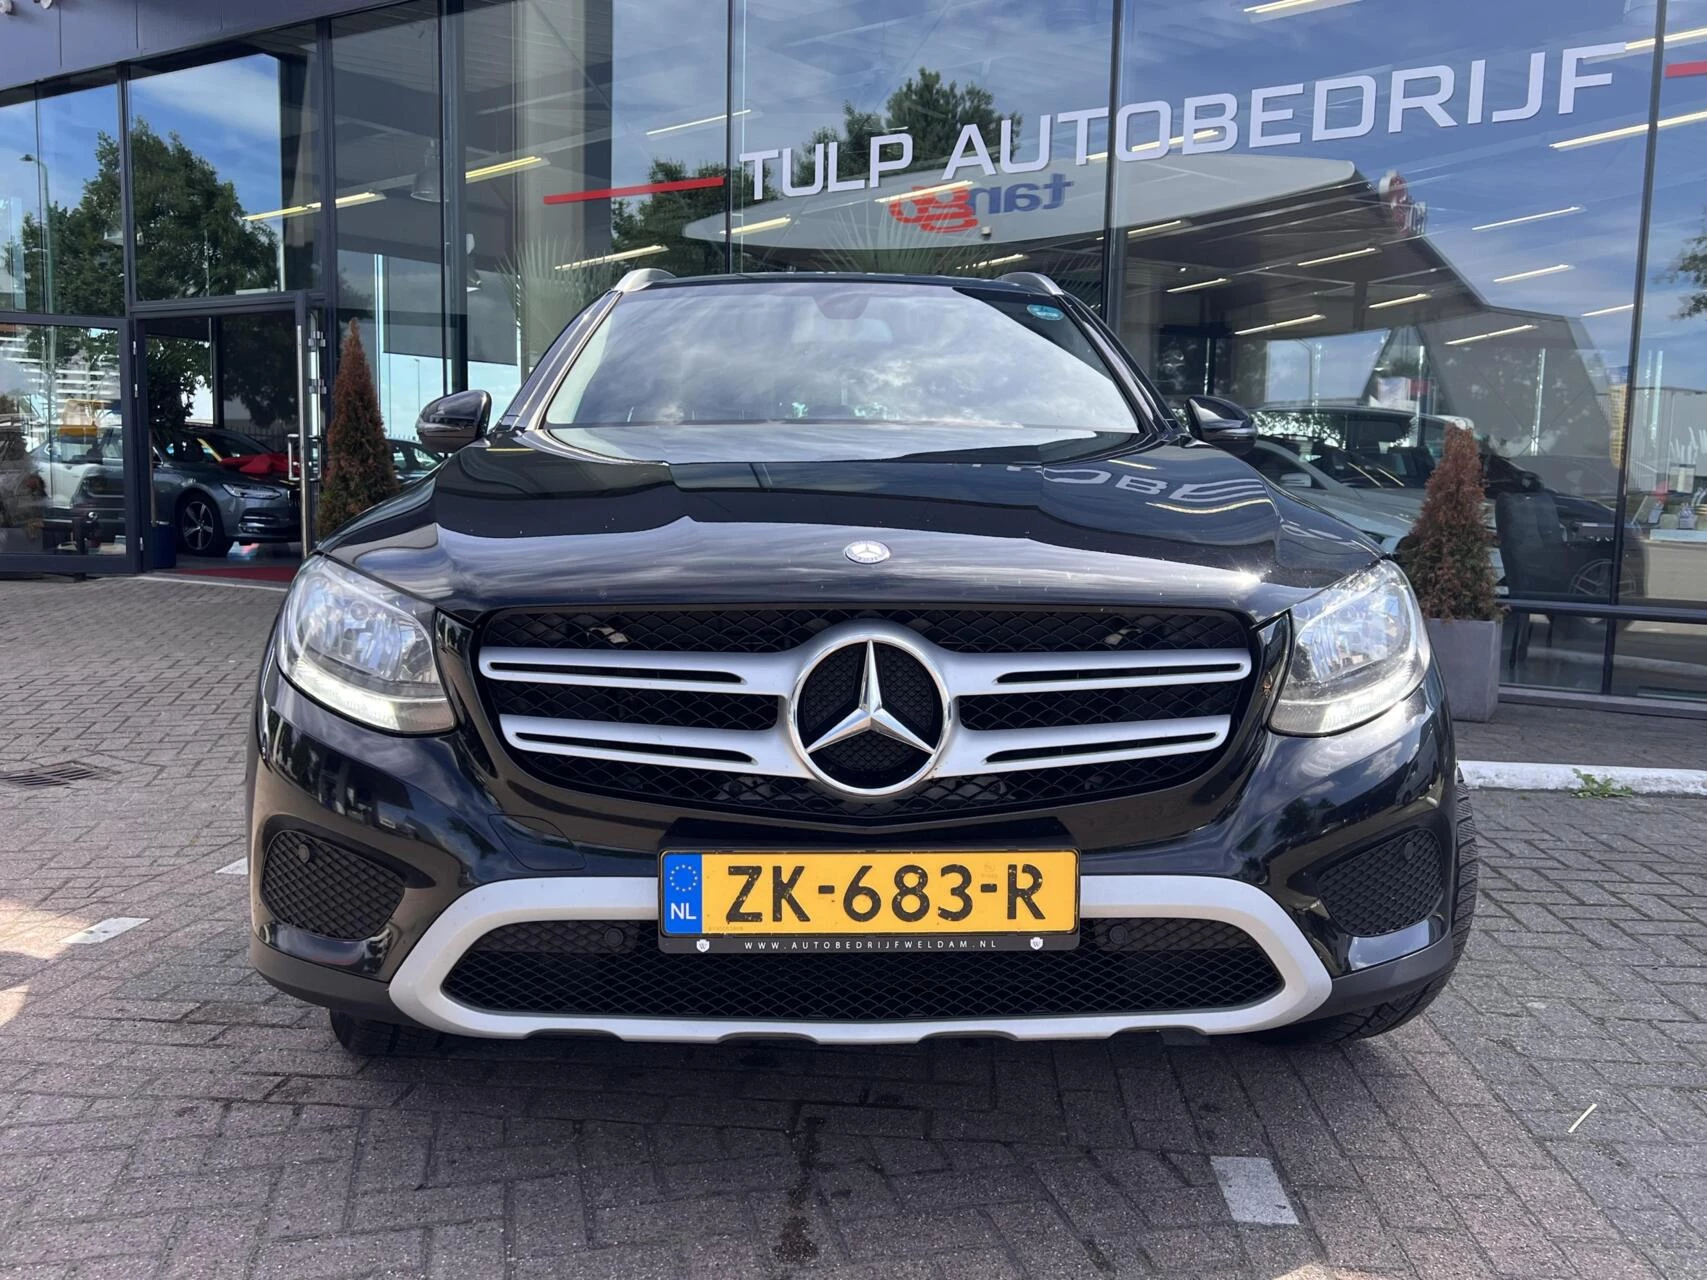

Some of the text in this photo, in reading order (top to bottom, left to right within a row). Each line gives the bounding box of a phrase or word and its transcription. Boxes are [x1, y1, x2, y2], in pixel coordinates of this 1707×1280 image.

[739, 41, 1627, 201] TULP AUTOBEDRIJF
[670, 902, 697, 920] NL
[726, 864, 1047, 923] ZK-683-R
